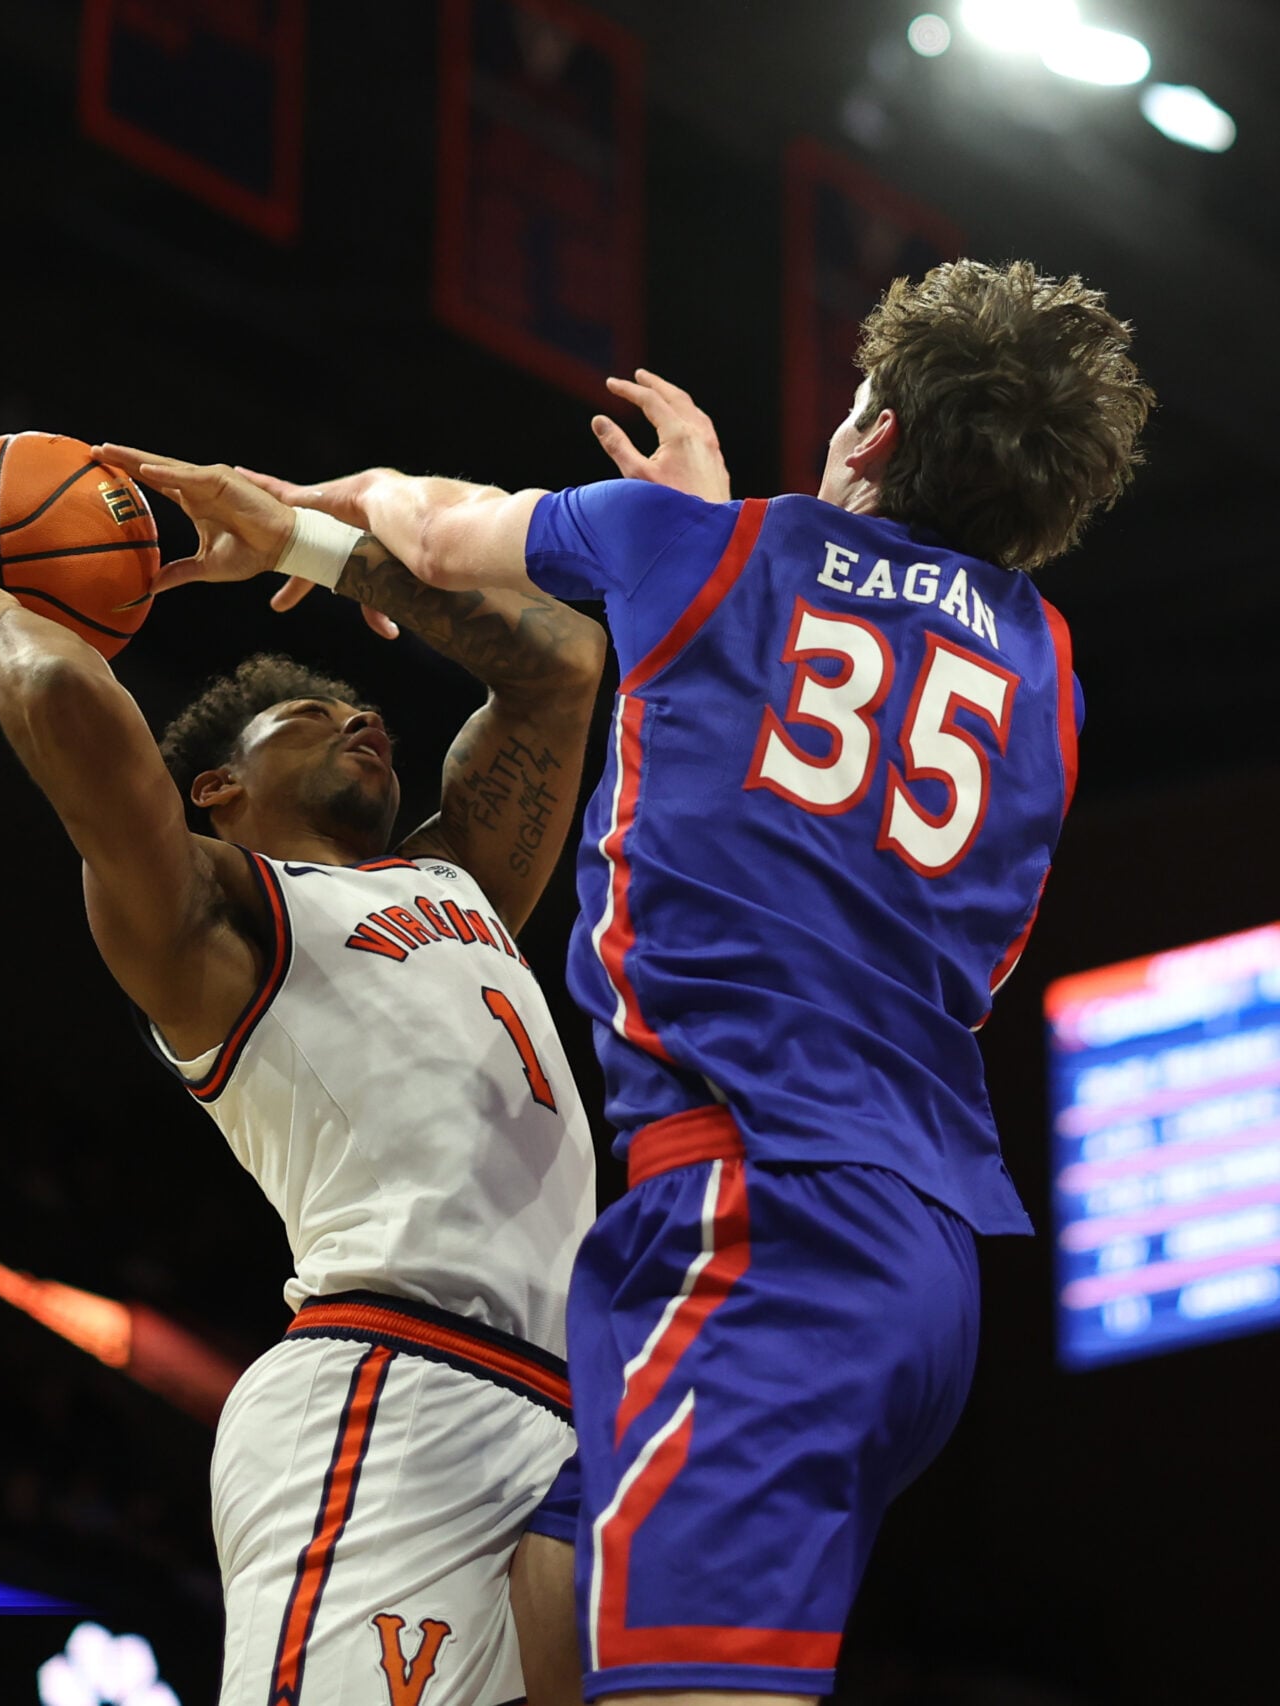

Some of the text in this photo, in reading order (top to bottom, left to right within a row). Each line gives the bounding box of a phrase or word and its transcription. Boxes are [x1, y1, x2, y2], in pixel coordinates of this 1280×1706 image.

[817, 541, 1000, 650] EAGAN
[471, 736, 524, 830] FAITH
[741, 594, 1020, 879] 35
[510, 782, 558, 878] SIGHT
[345, 896, 531, 971] VIRGINI
[481, 986, 558, 1115] 1
[371, 1612, 452, 1706] V
